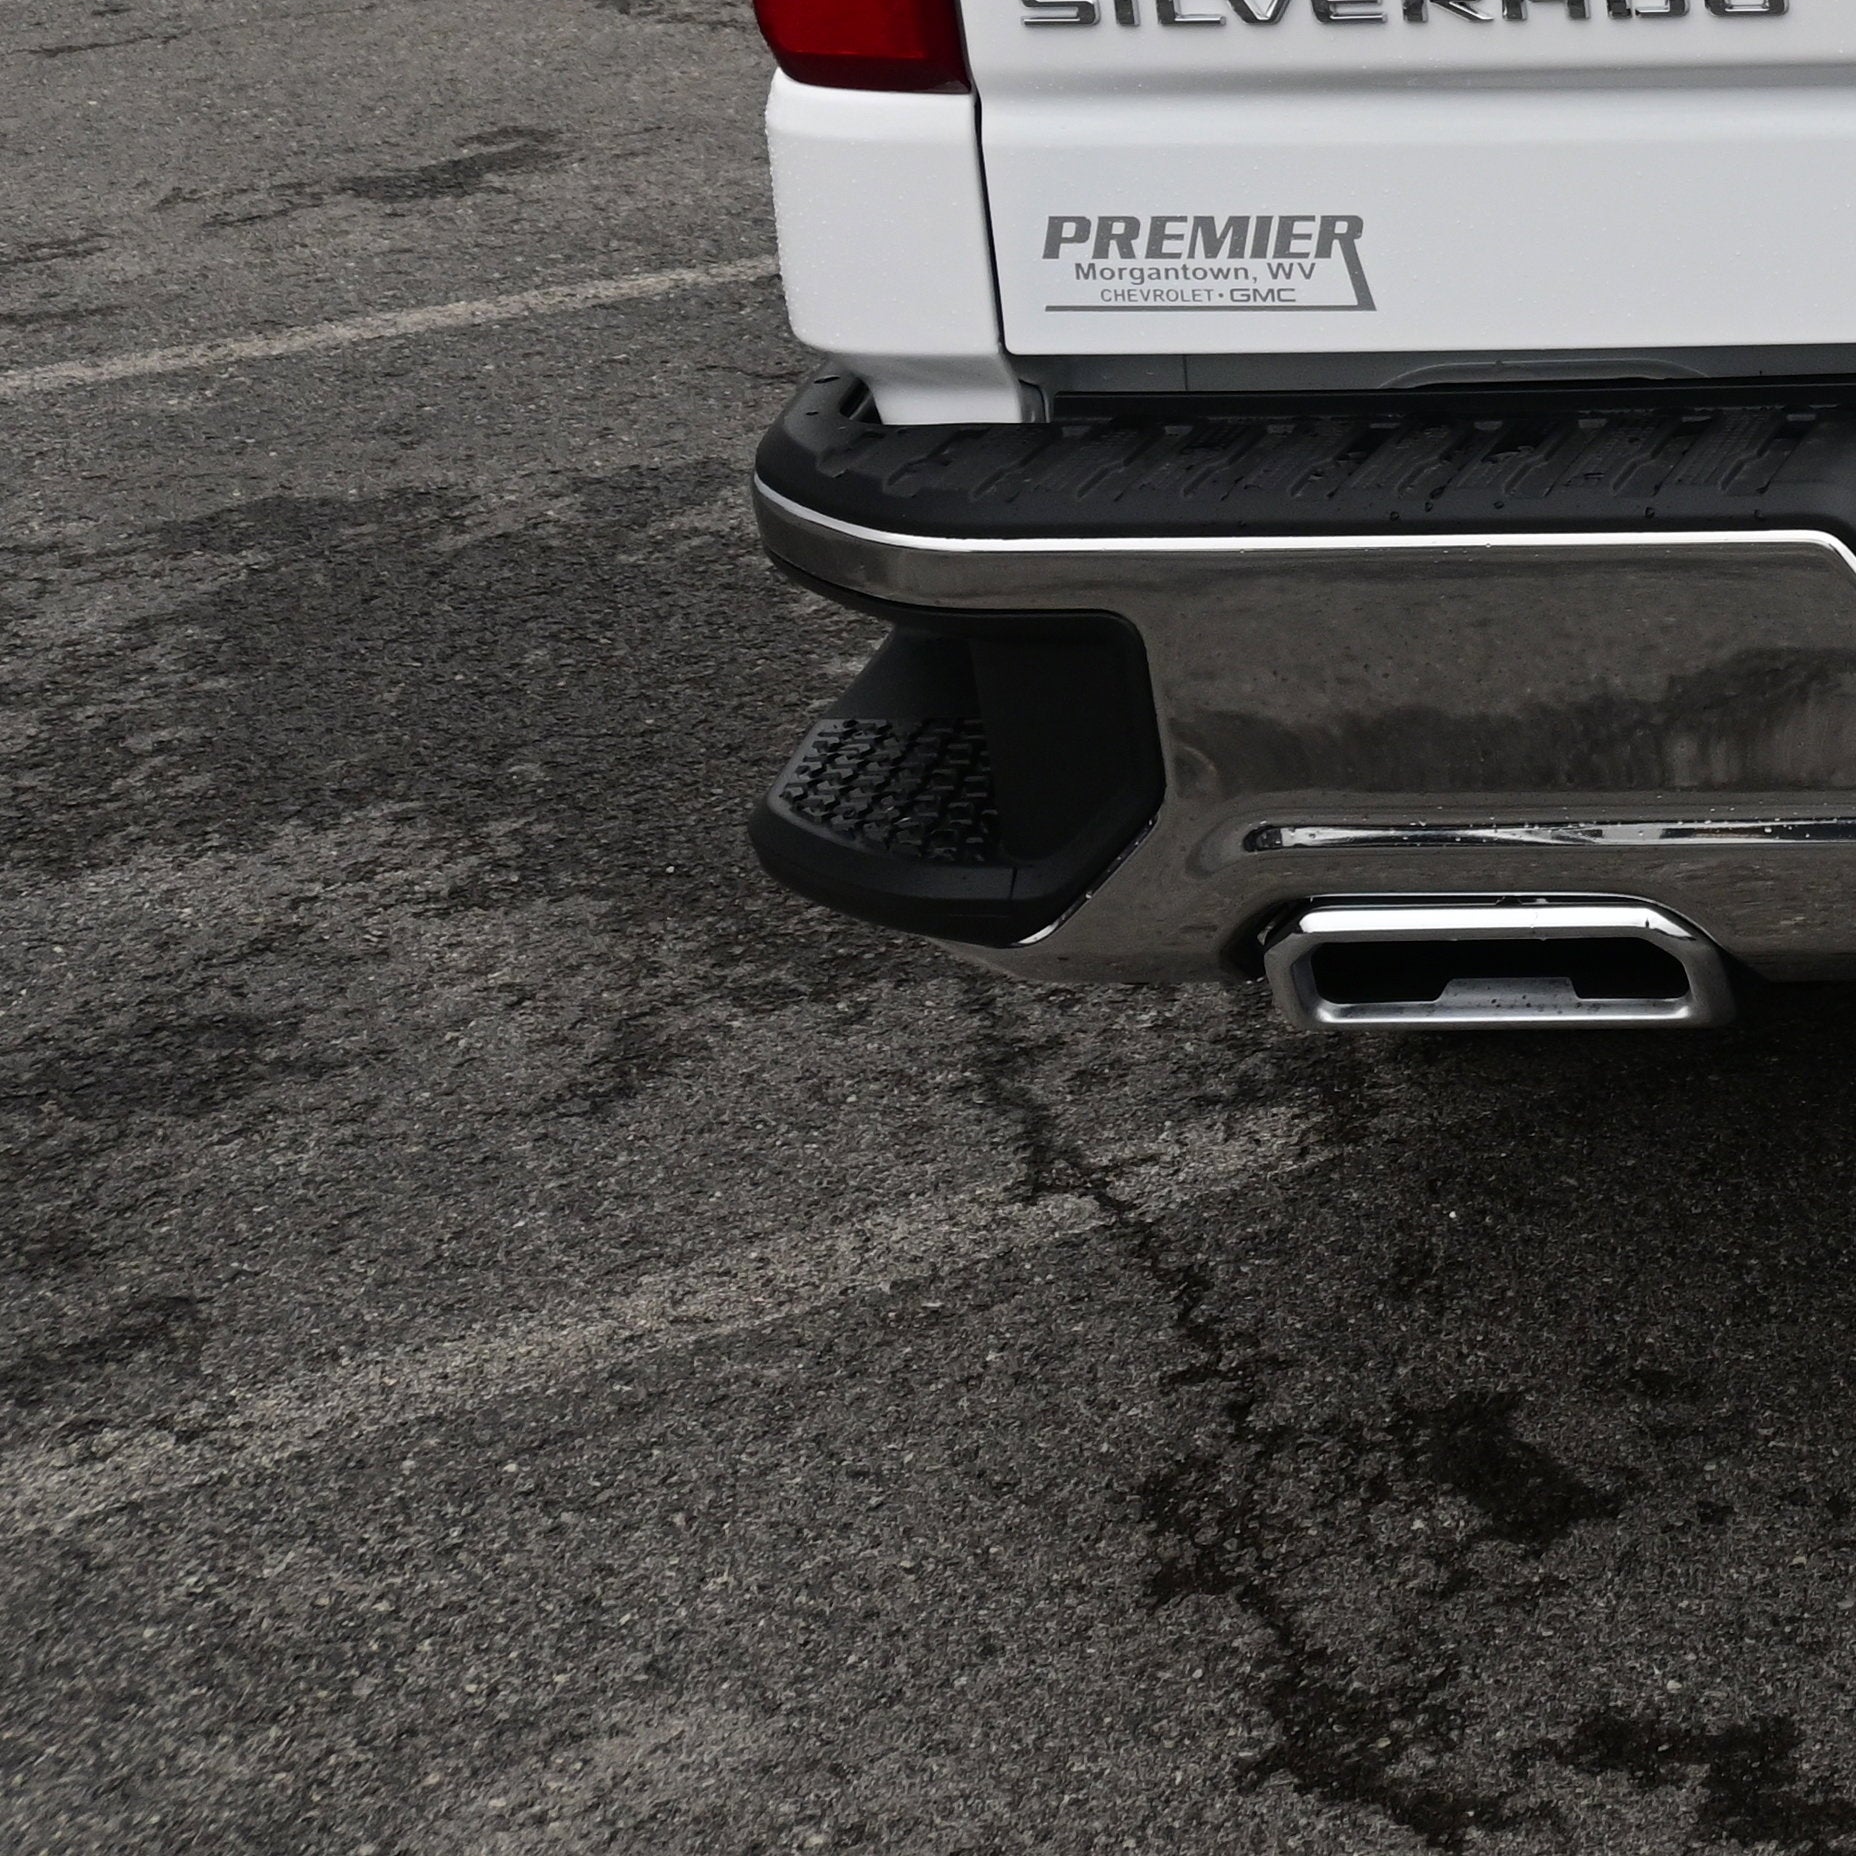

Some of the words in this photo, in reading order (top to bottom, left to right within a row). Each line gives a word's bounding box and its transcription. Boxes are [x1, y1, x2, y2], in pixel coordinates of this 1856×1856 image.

[1042, 215, 1367, 282] PREMIER
[1074, 263, 1258, 285] Morgantown,
[1266, 262, 1316, 281] WV
[1100, 288, 1215, 302] CHEVROLET
[1229, 288, 1296, 302] GMC
